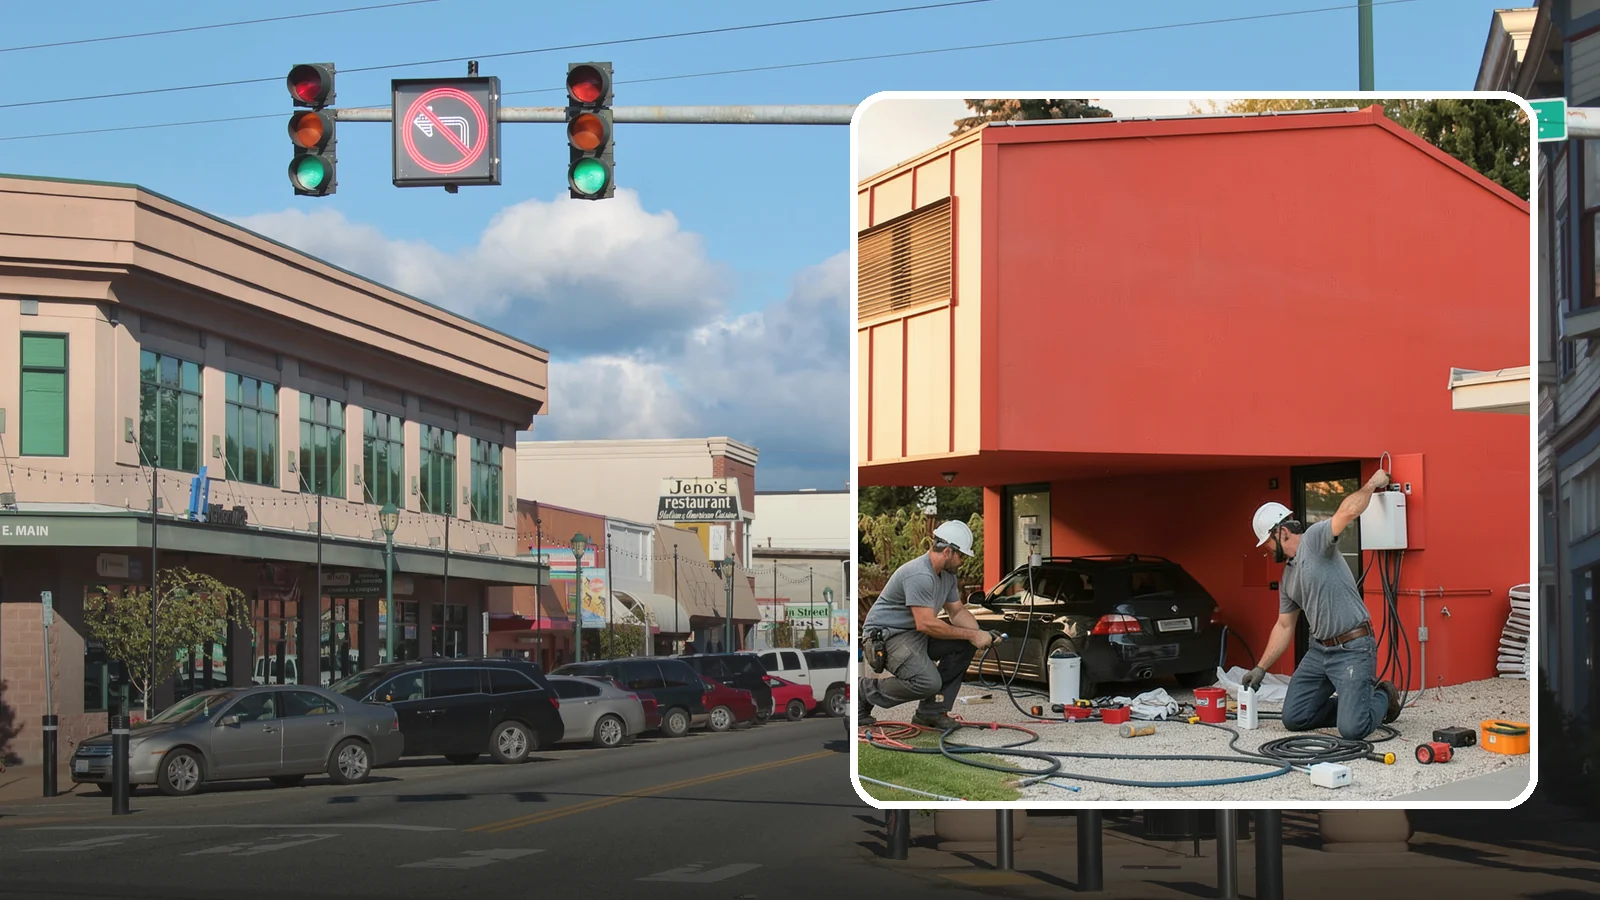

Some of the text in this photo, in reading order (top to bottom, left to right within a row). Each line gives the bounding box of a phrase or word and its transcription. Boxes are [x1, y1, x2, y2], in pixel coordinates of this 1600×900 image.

[670, 480, 727, 495] Jeno's
[665, 496, 731, 509] restaurant
[659, 509, 681, 519] Italian
[686, 509, 714, 519] American
[715, 509, 738, 519] Cuisine
[2, 525, 49, 536] E. MAIN
[797, 607, 828, 617] Street
[791, 619, 823, 627] lass
